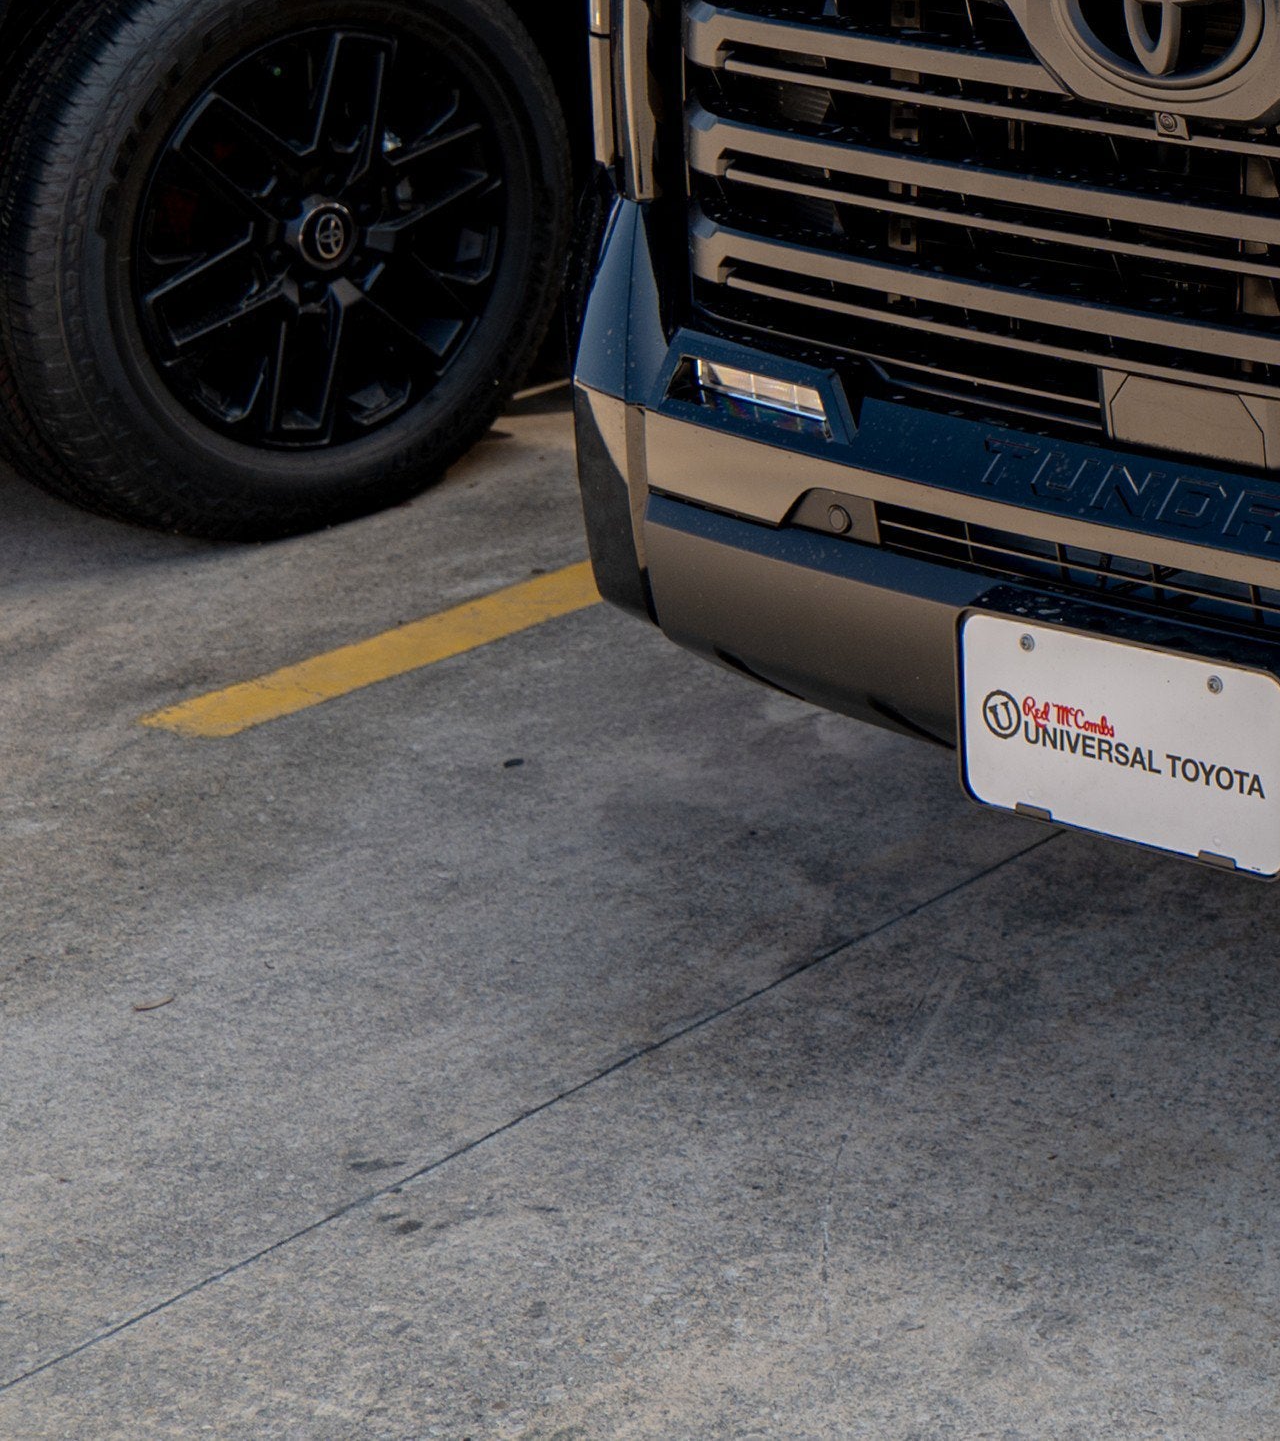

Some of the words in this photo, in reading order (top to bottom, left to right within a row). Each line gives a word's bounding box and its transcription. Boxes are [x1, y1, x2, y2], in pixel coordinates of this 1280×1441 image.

[1022, 696, 1050, 729] Red
[1052, 702, 1115, 738] McCombs
[1024, 721, 1162, 774] UNIVERSAL
[1166, 753, 1266, 799] TOYOTA
